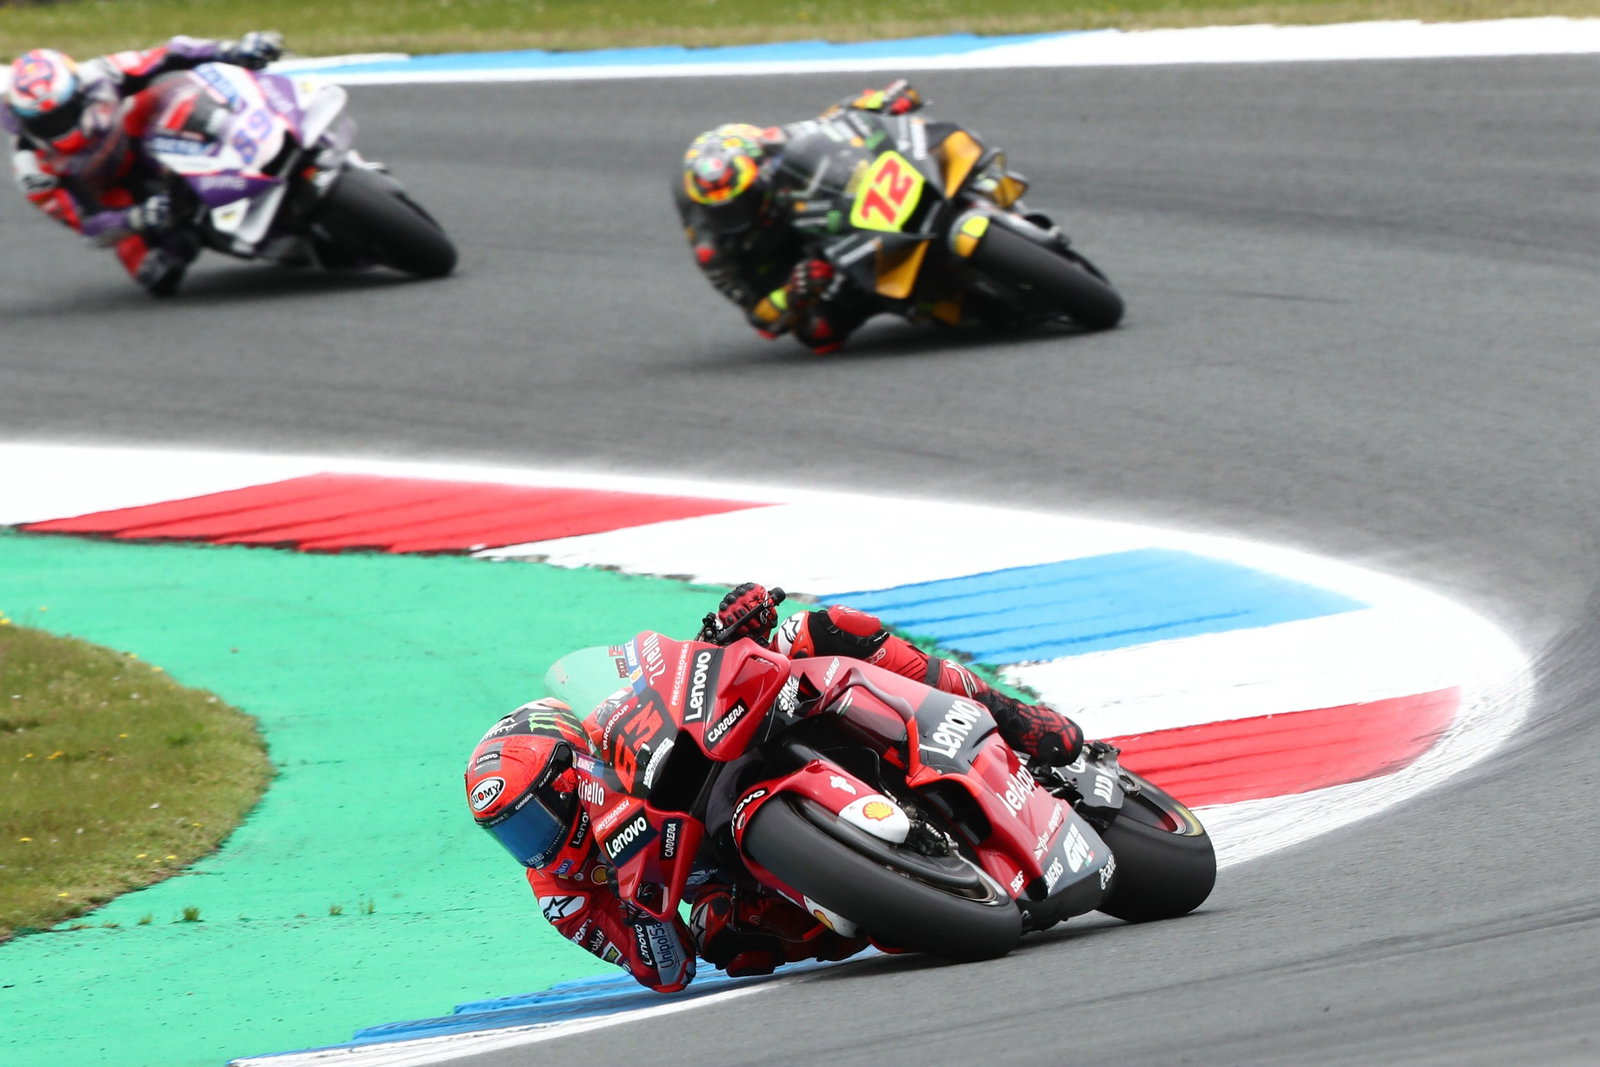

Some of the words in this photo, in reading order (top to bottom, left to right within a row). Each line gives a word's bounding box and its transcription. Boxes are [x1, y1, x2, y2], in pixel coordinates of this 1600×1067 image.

[860, 157, 914, 225] 72
[671, 643, 690, 706] FRECCIAROSSA
[685, 651, 712, 722] Lenovo
[707, 704, 745, 743] CARRERA
[919, 700, 982, 759] Lenovo
[572, 811, 589, 845] Leno
[605, 816, 647, 859] Lenovo
[664, 823, 677, 857] CARRERA
[1010, 869, 1025, 893] SKF
[634, 924, 653, 966] Lenovo
[649, 922, 675, 968] UnipolSa
